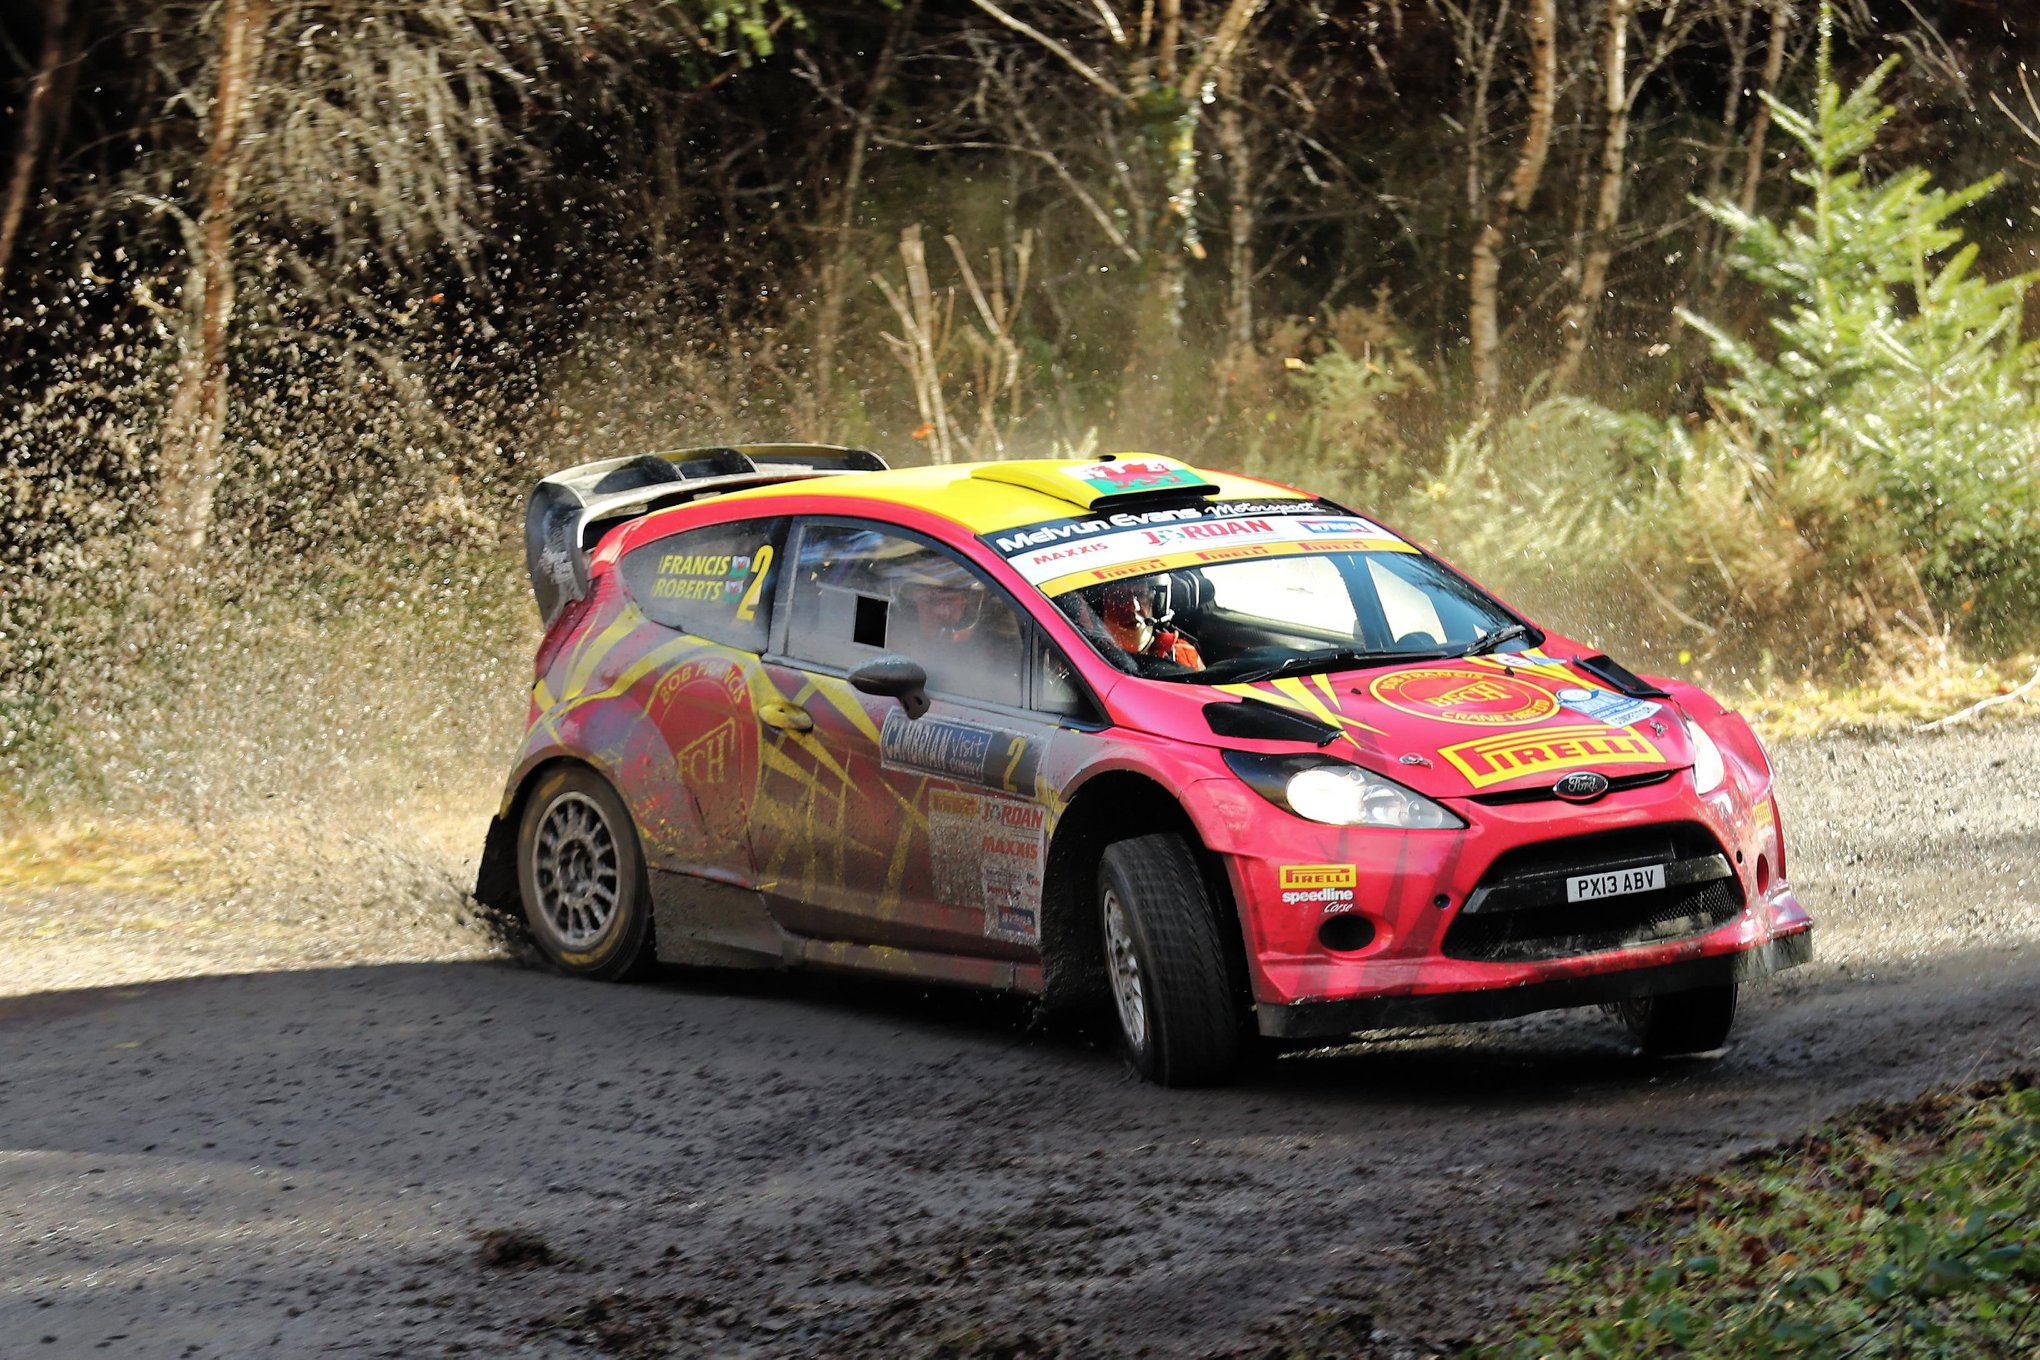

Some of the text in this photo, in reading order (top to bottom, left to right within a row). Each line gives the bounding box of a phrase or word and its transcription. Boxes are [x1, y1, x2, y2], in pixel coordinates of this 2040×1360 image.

[1109, 508, 1202, 528] Evans
[1204, 502, 1321, 519] Motorsport
[1033, 542, 1109, 565] MAXXIS
[1195, 545, 1270, 561] PIRELLI
[1296, 541, 1369, 551] PIRELLI
[658, 554, 731, 576] FRANCIS
[1091, 559, 1167, 579] PIRELLI
[653, 578, 724, 600] ROBERTS
[736, 544, 774, 621] 2
[661, 665, 692, 705] BOB
[1441, 710, 1506, 722] CRANE
[951, 730, 985, 759] Visit
[1453, 727, 1650, 777] PIRELLI
[1003, 736, 1026, 793] 2
[1567, 775, 1599, 793] Ford
[982, 835, 1039, 860] MAXXIS
[1286, 868, 1350, 883] PIRELLI
[1578, 869, 1655, 899] PX13 ABV
[1282, 887, 1354, 905] speedline
[1324, 901, 1354, 913] Corse
